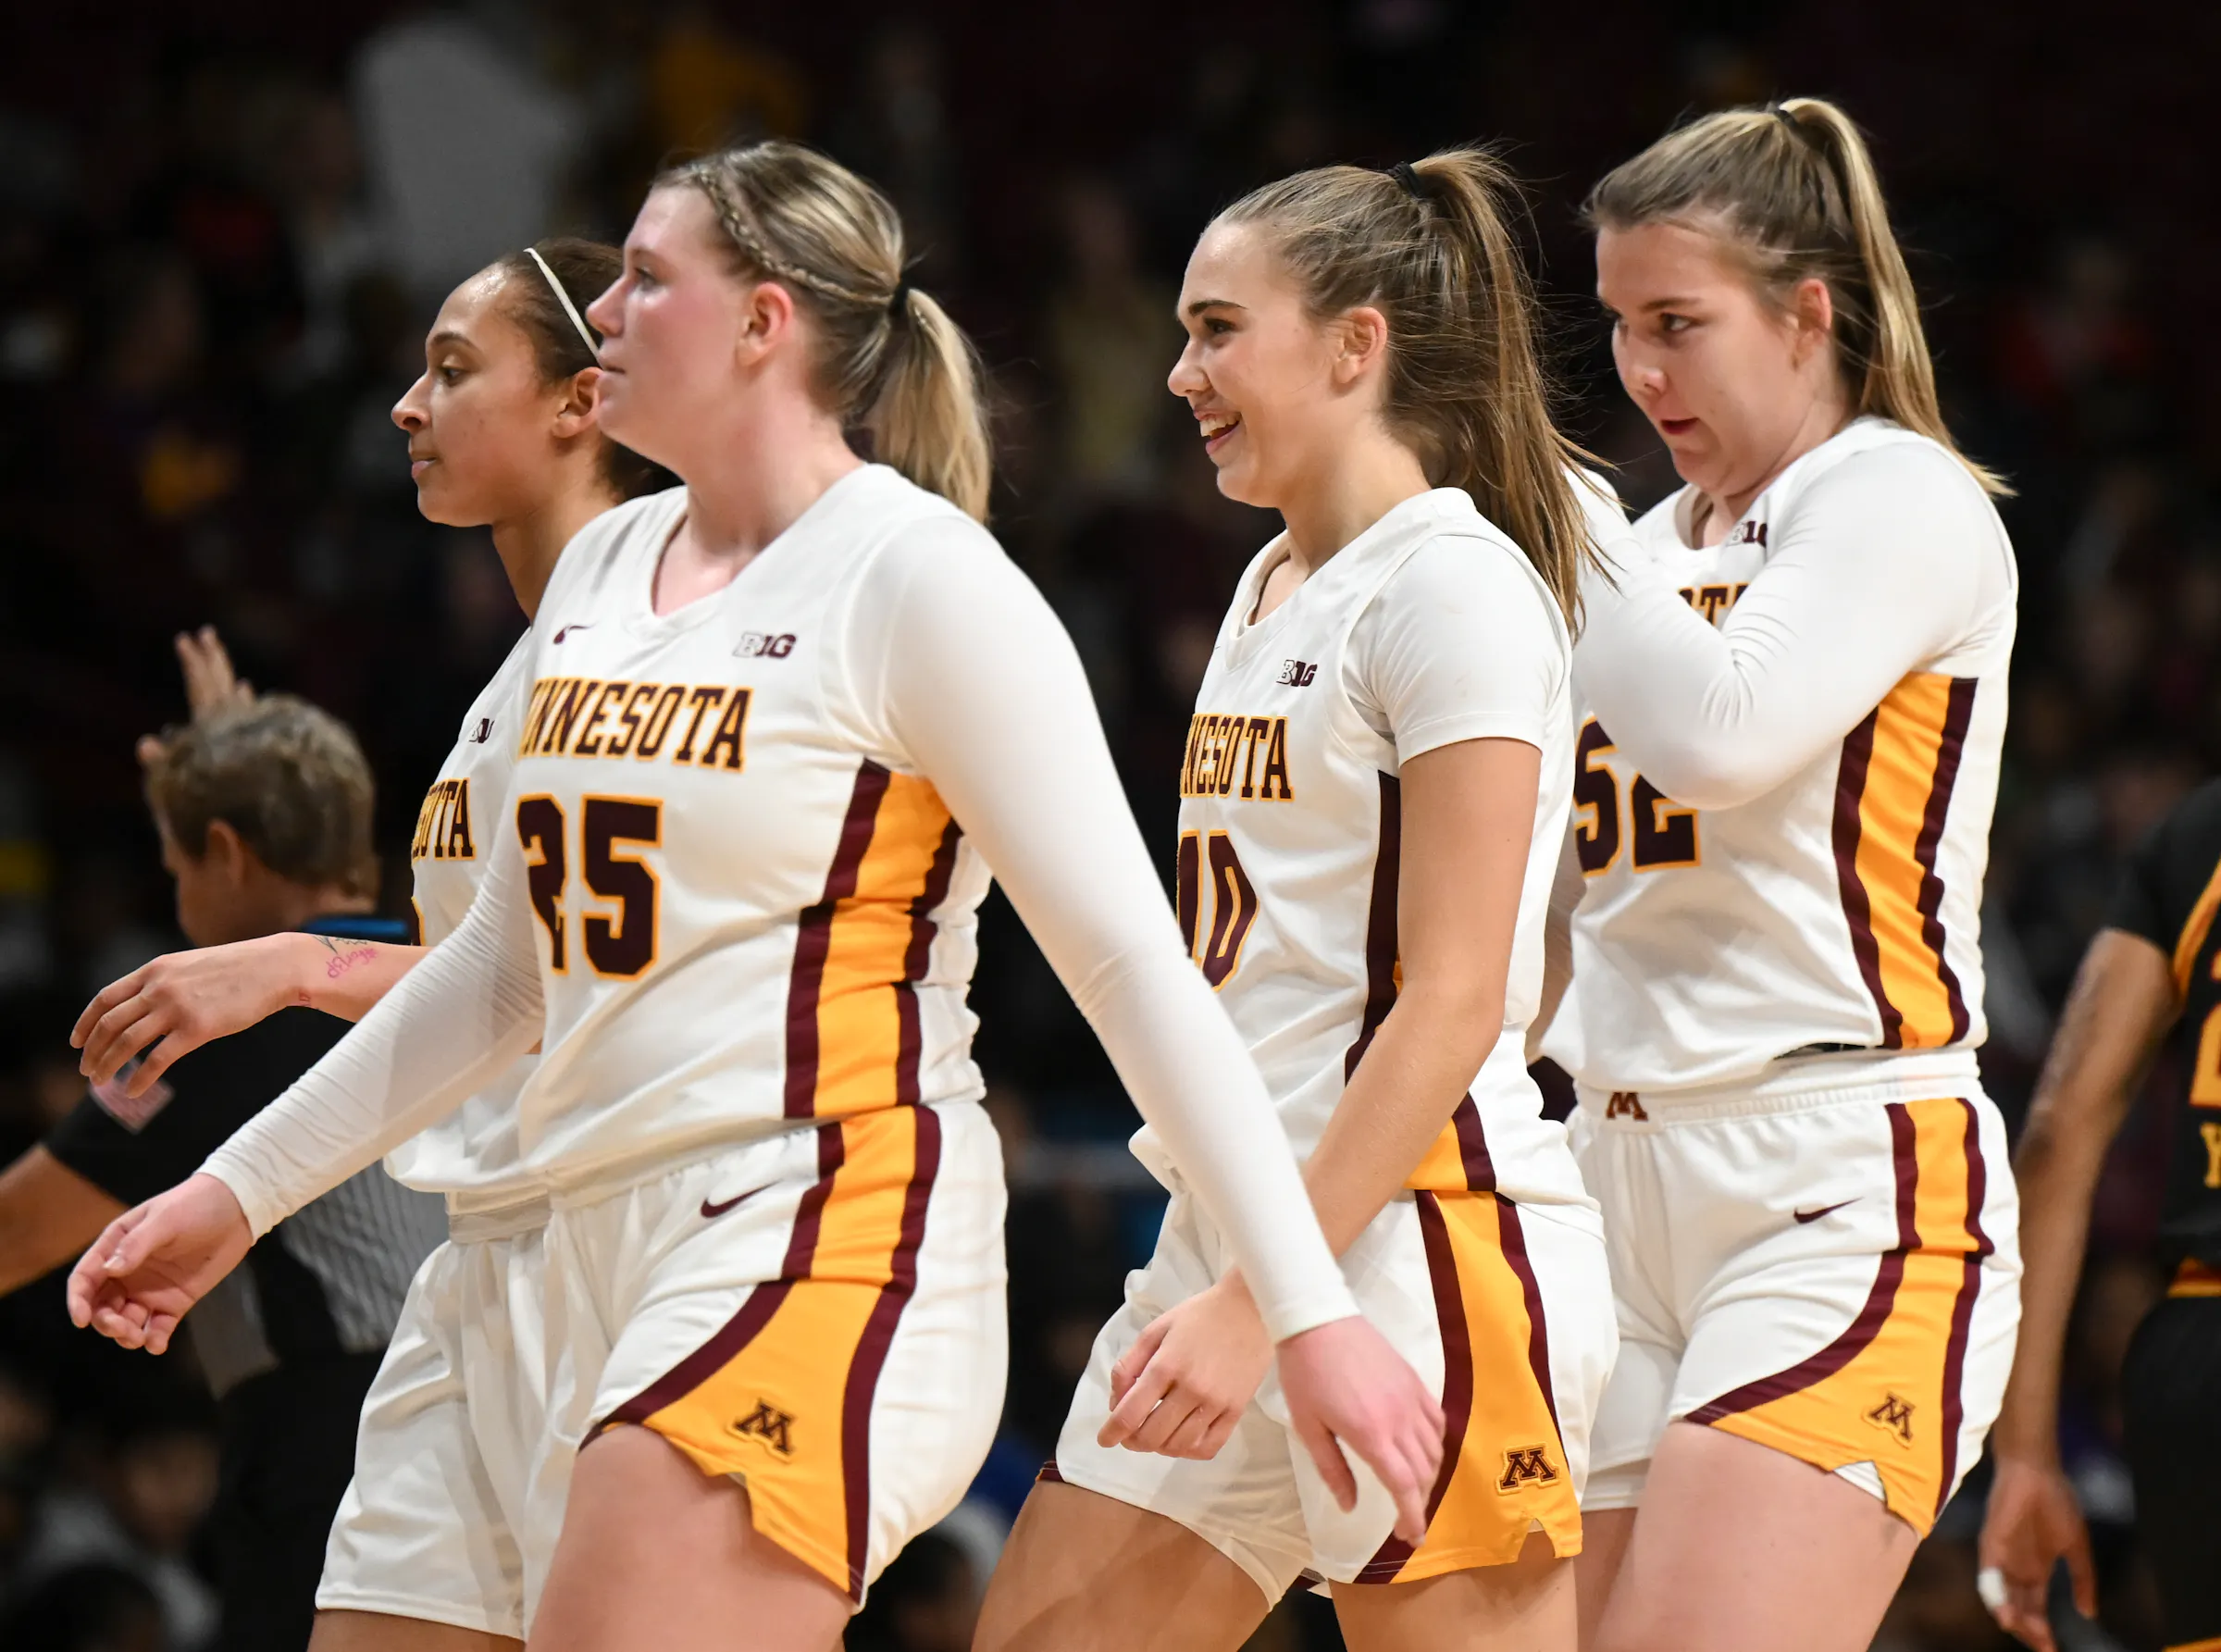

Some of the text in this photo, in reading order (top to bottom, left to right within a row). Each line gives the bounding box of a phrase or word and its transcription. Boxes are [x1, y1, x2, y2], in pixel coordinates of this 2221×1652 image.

[515, 792, 664, 982] 25
[1177, 828, 1259, 992] 10
[1606, 1090, 1648, 1120] M
[732, 1400, 796, 1457] M
[1867, 1394, 1914, 1441] M
[1499, 1447, 1557, 1490] M
